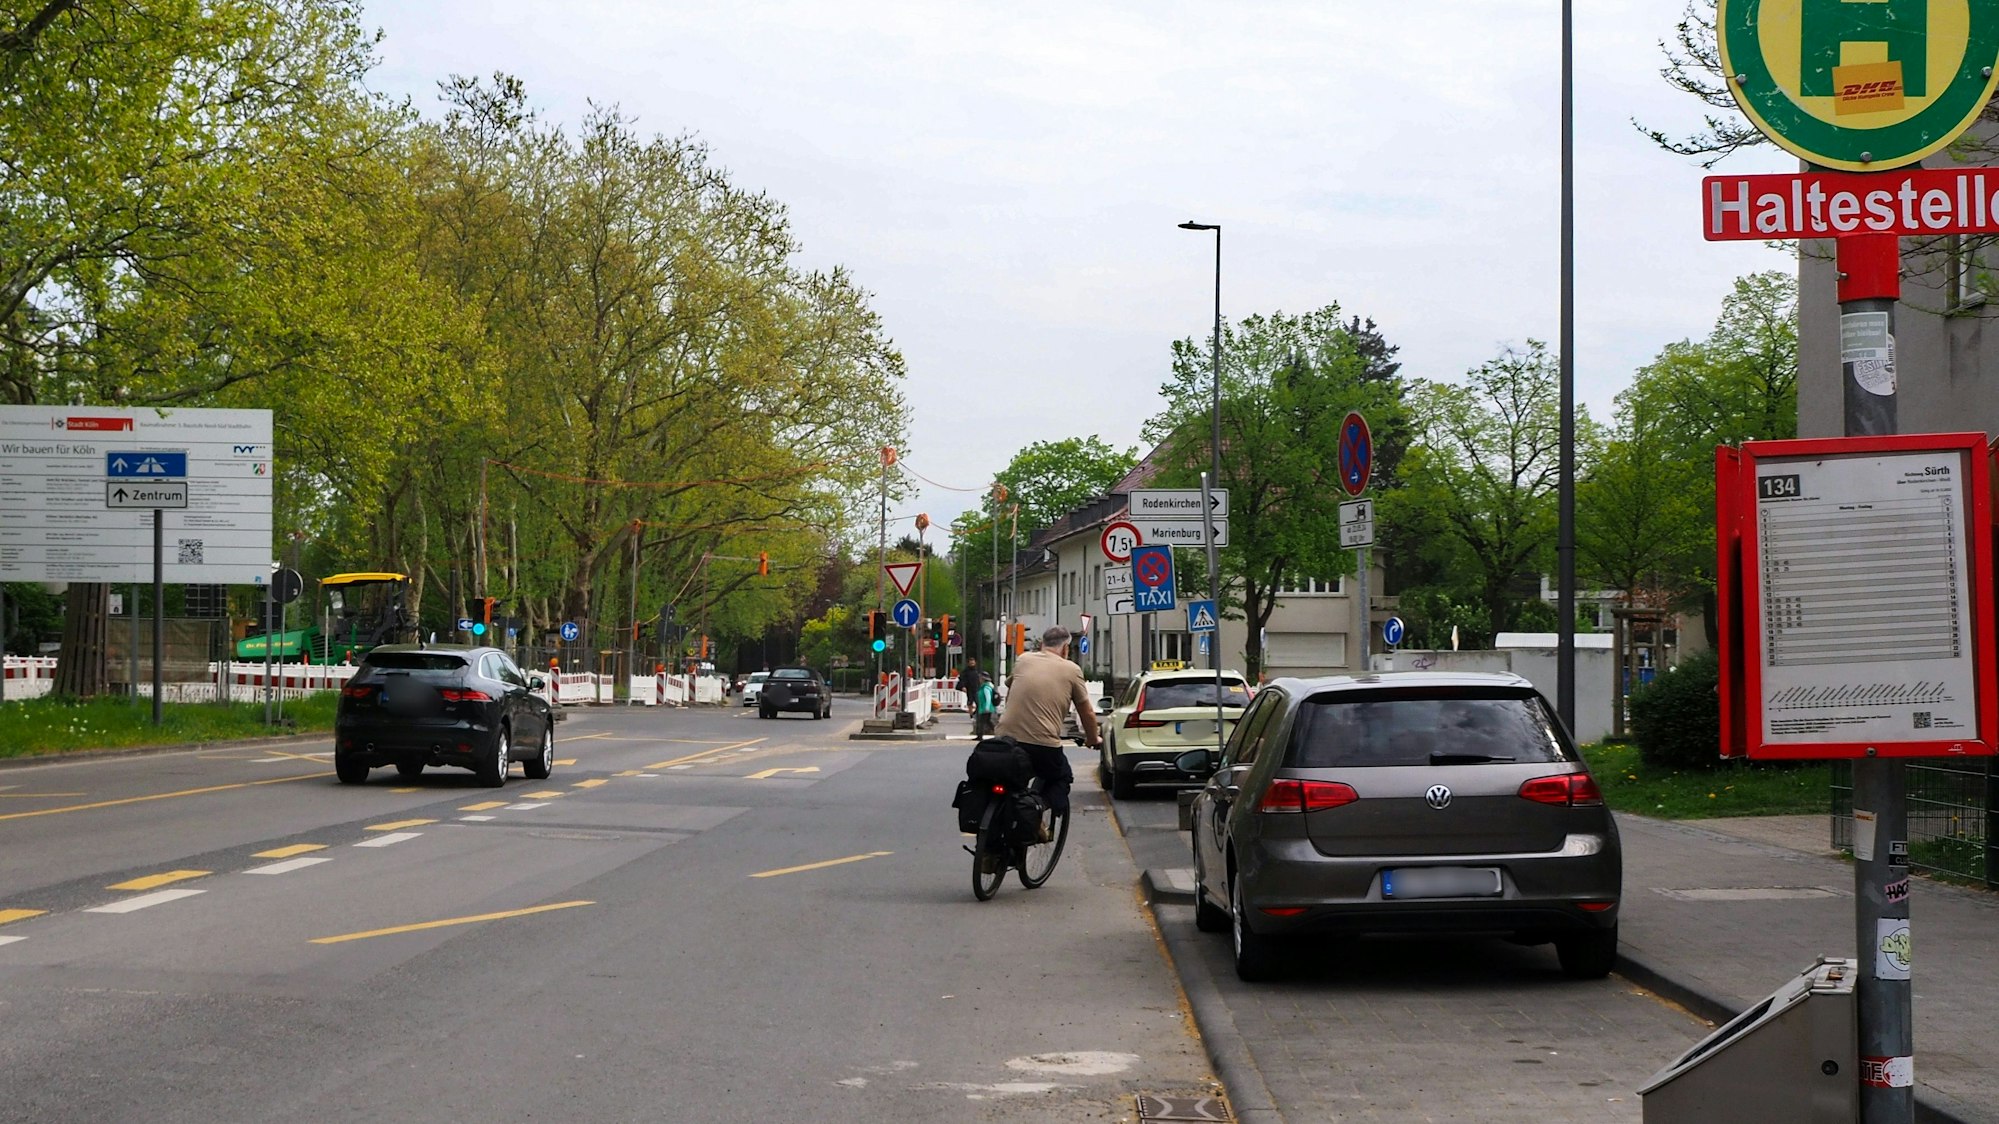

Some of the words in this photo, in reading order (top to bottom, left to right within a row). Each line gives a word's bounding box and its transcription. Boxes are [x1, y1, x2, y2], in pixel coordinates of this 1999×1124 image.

[1711, 174, 1999, 234] Haltestell
[2, 444, 20, 453] Wir
[22, 444, 54, 454] bauen
[56, 444, 70, 454] für
[73, 445, 96, 455] Köln
[1924, 466, 1950, 476] Sürth
[1764, 477, 1795, 496] 134
[133, 490, 182, 500] Zentrum
[1142, 498, 1201, 508] Rodenkirchen
[1152, 528, 1201, 540] Marienburg
[1109, 536, 1133, 553] 7,5t
[1108, 576, 1126, 584] 21-6
[1138, 591, 1172, 606] TAXI
